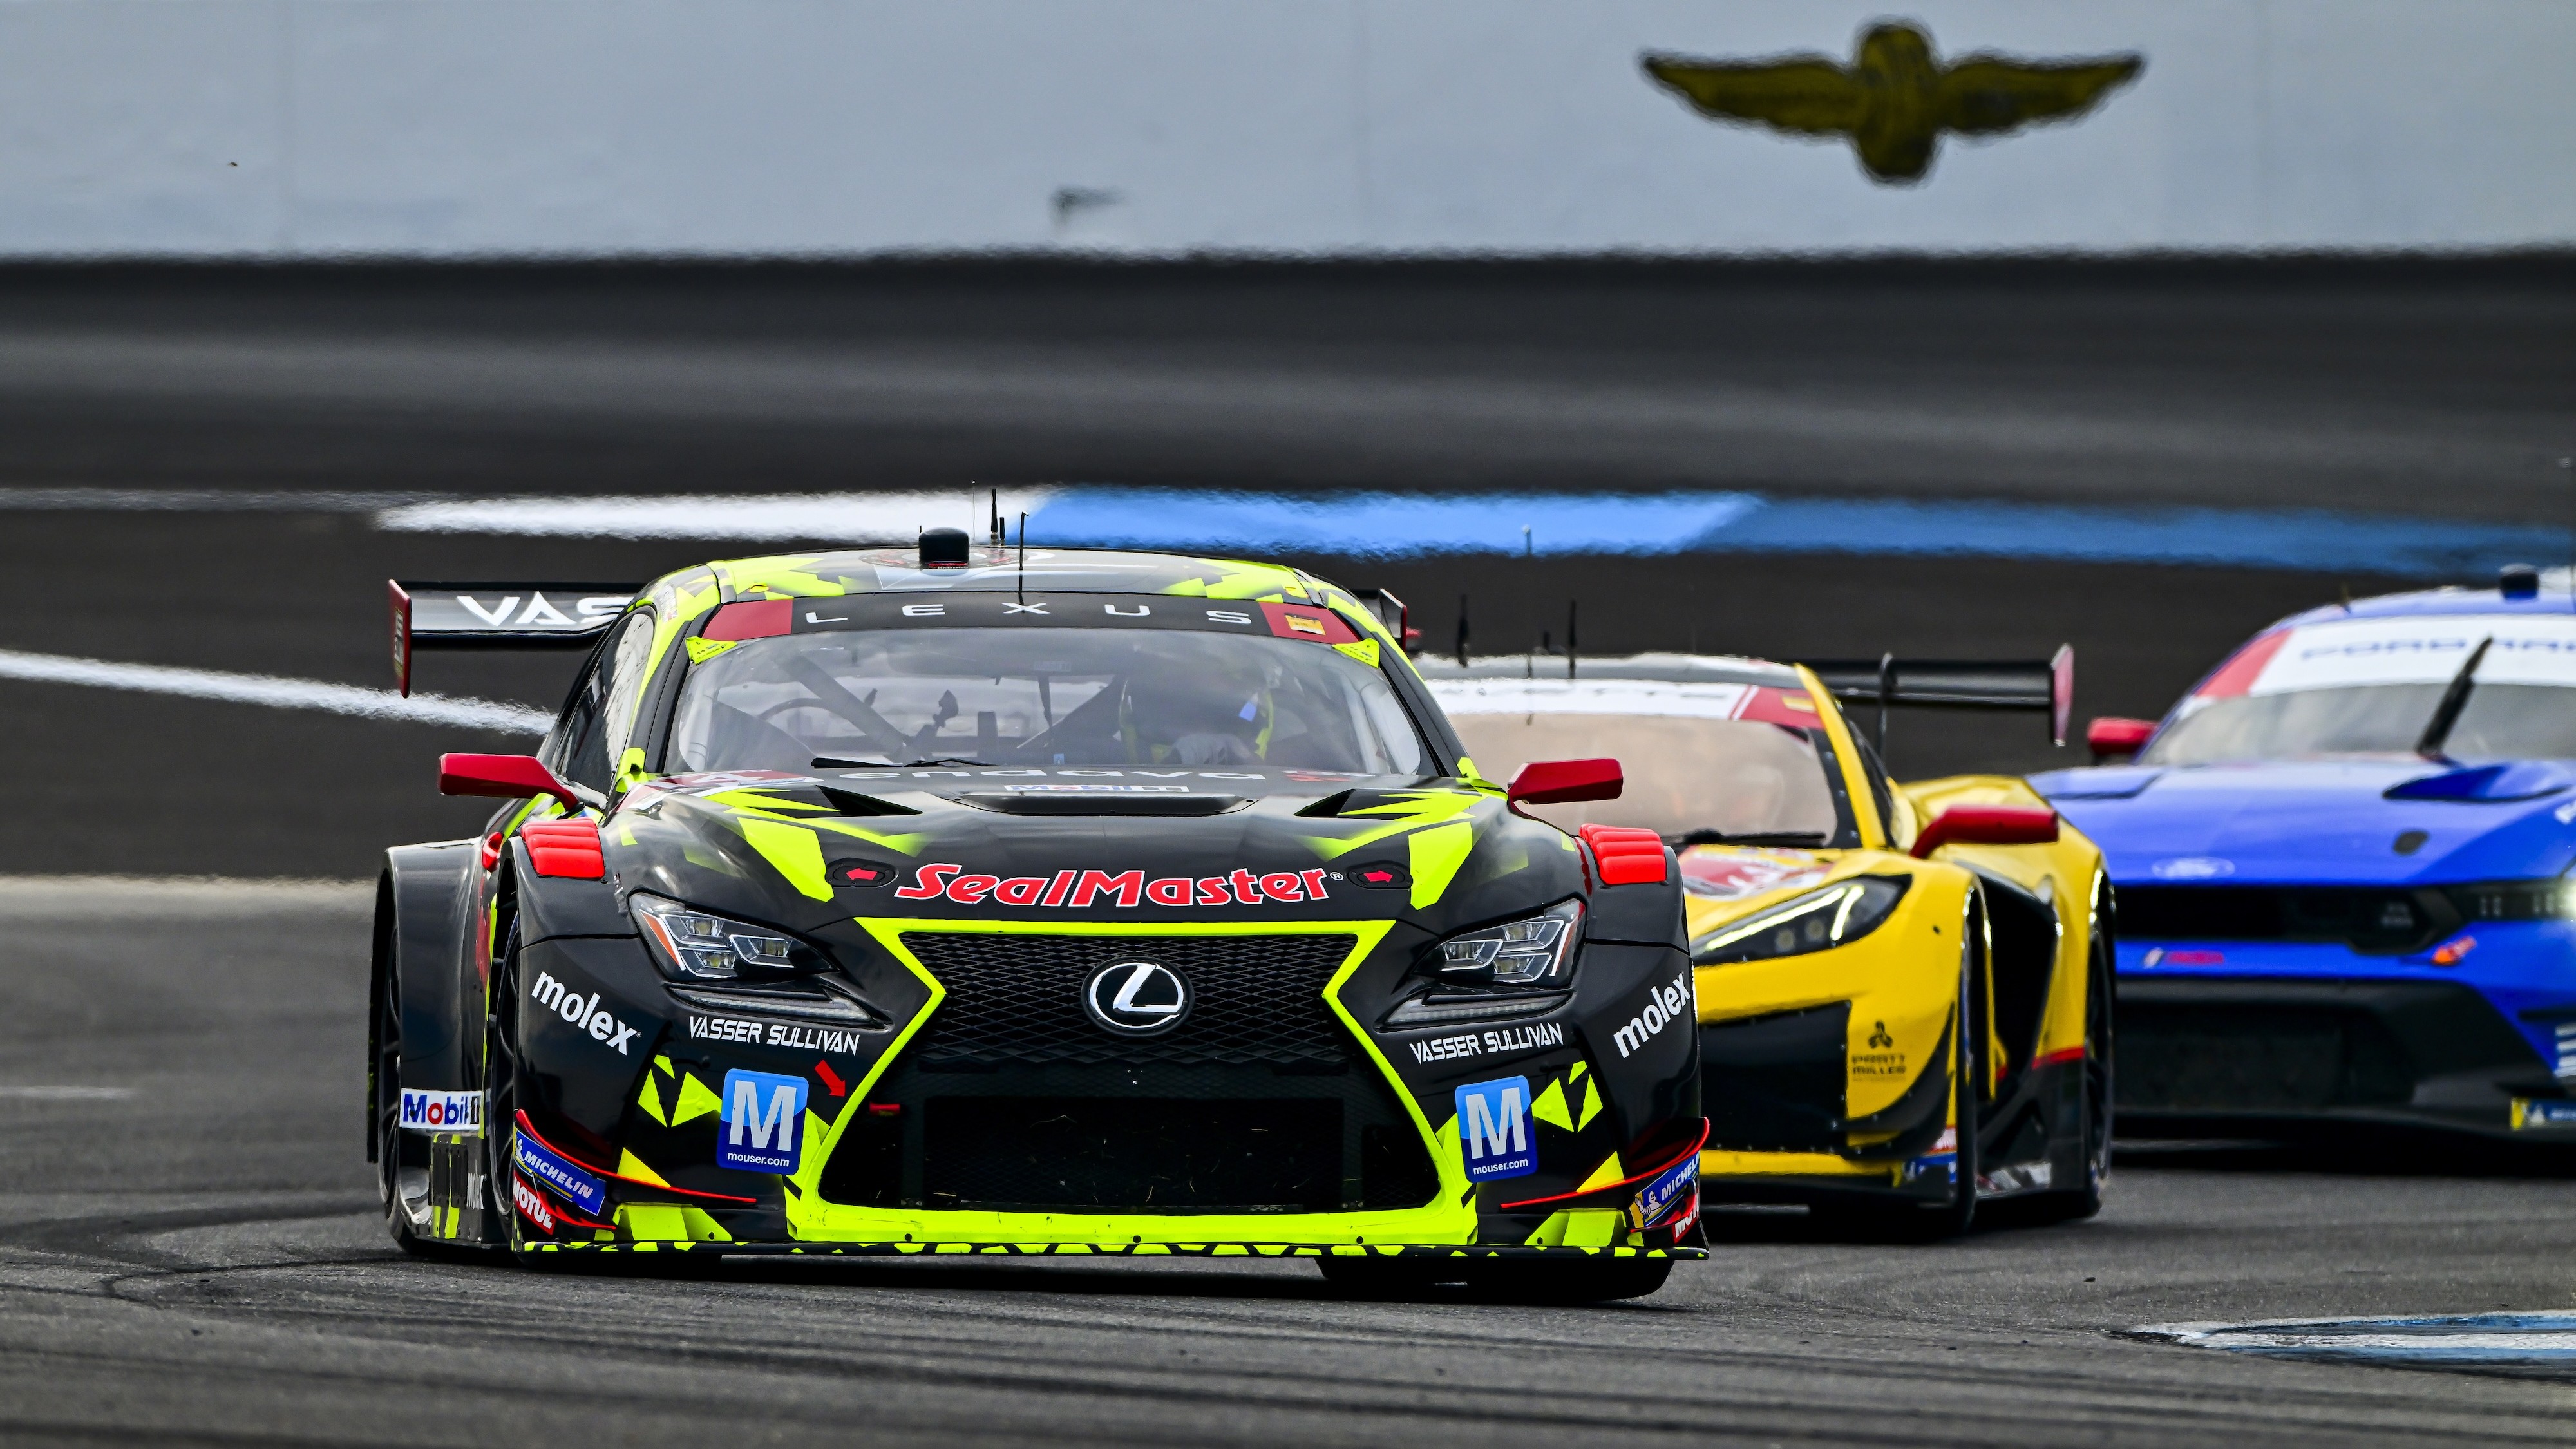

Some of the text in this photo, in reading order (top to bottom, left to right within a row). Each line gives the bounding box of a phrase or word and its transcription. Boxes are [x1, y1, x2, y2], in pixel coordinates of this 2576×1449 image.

[805, 603, 1253, 625] LEXUS
[839, 769, 1266, 780] endava
[531, 971, 638, 1056] molex
[1613, 972, 1690, 1059] molex
[690, 1015, 860, 1056] VASSER SULLIVAN
[1409, 1022, 1564, 1065] VASSER SULLIVAN
[403, 1094, 468, 1125] Mobil
[729, 1080, 797, 1151] M
[1465, 1087, 1526, 1159] M
[524, 1151, 594, 1198] MICHELIN
[727, 1152, 790, 1167] mouser.com
[1473, 1159, 1528, 1175] mouser.com
[513, 1176, 553, 1229] MOTUL
